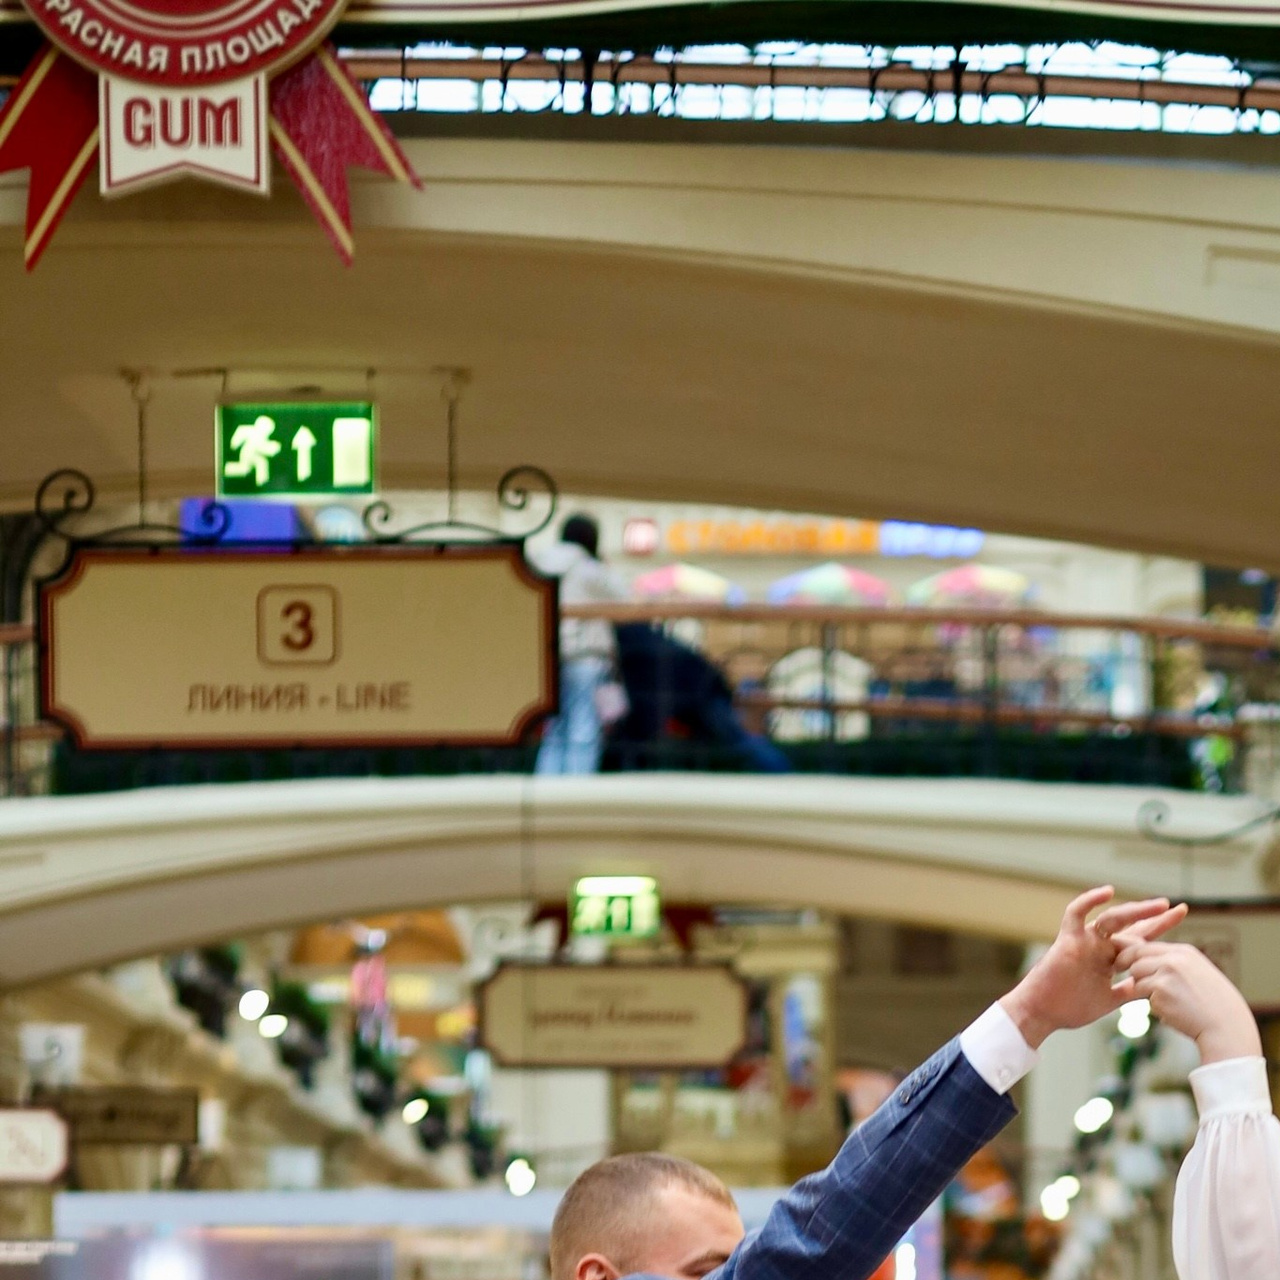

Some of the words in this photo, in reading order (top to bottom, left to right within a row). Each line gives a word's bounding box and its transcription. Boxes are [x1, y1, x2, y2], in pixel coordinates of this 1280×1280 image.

[44, 0, 169, 73] РАСНАЯ
[123, 97, 241, 148] GUM
[281, 600, 315, 651] 3
[187, 682, 309, 715] ЛИНИЯ
[336, 681, 411, 714] LINE
